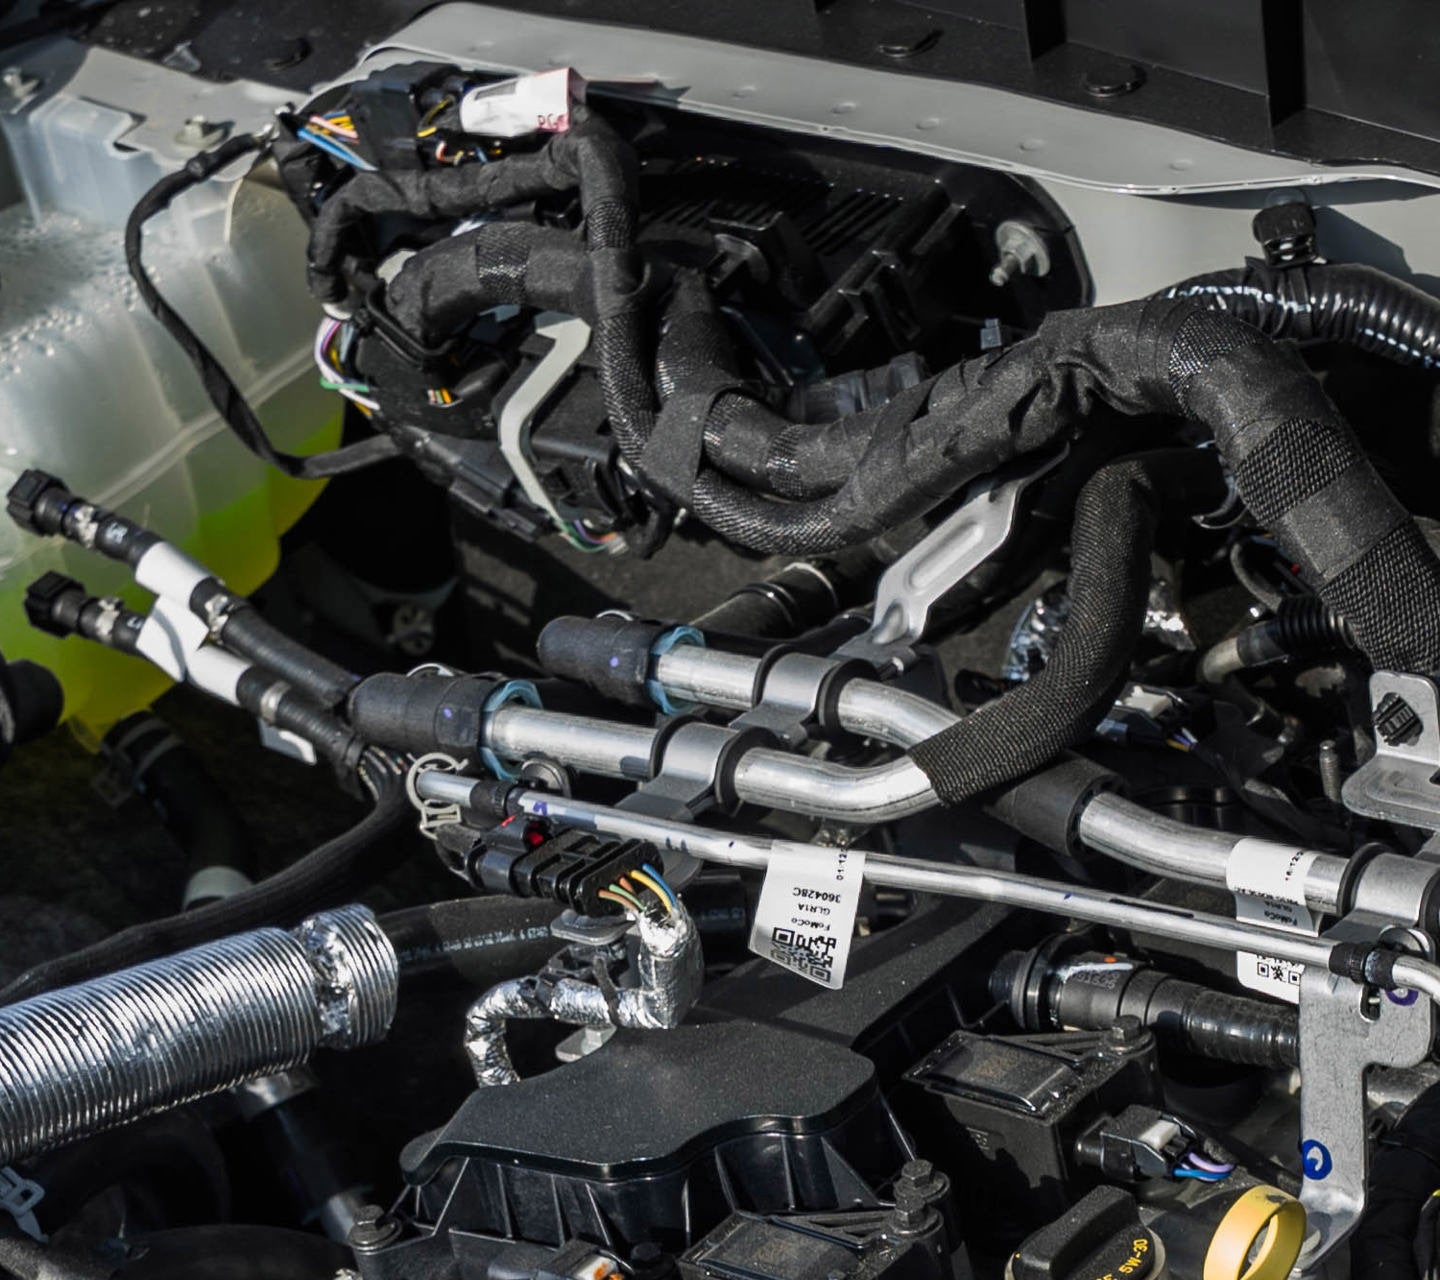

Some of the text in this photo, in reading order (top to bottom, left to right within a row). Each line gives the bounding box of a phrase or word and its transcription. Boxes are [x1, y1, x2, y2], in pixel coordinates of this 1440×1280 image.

[792, 886, 840, 904] 360428C
[790, 916, 830, 930] FoMoCo
[1116, 1238, 1149, 1276] 5W-30
